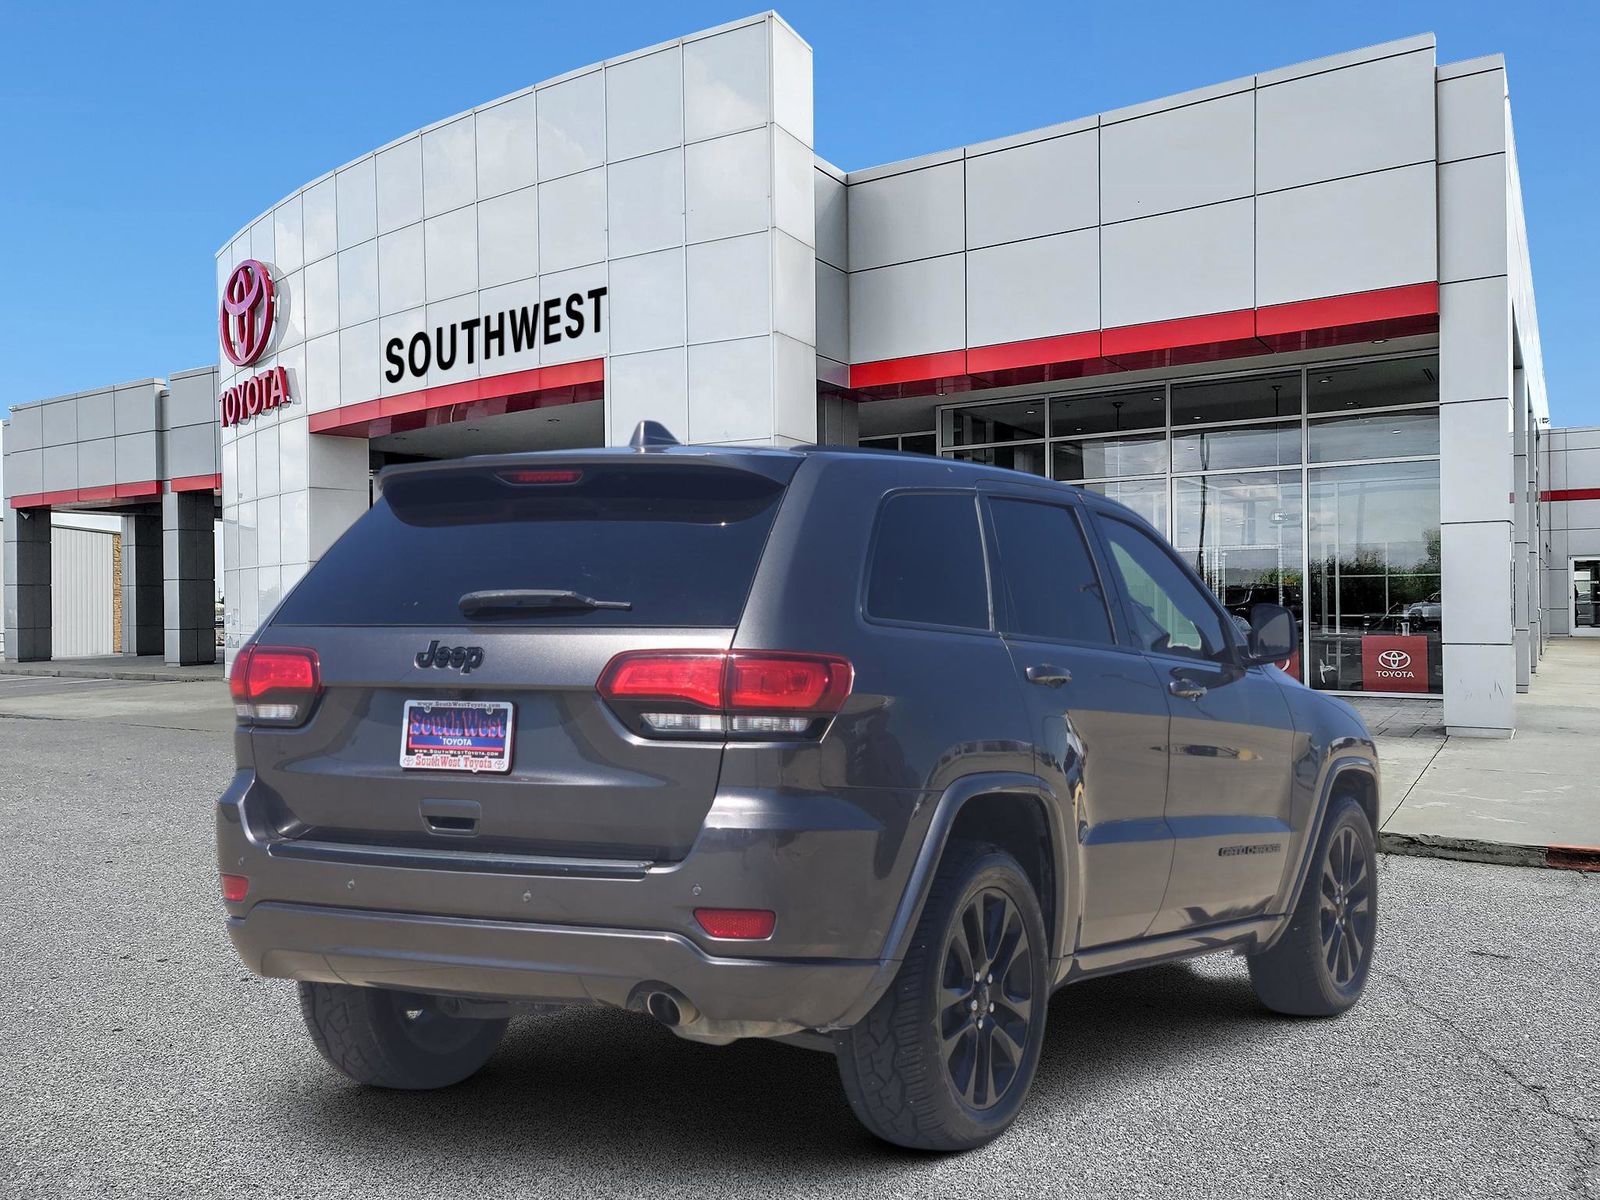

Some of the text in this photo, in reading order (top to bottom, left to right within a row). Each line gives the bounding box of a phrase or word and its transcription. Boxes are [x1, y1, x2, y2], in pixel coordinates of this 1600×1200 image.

[385, 286, 608, 384] SOUTHWEST
[218, 366, 290, 428] TOYOTA
[414, 640, 484, 675] Jeep
[1376, 670, 1415, 678] TOYOTA
[442, 738, 472, 746] TOYOTA
[415, 755, 492, 769] SouthWest Toyota
